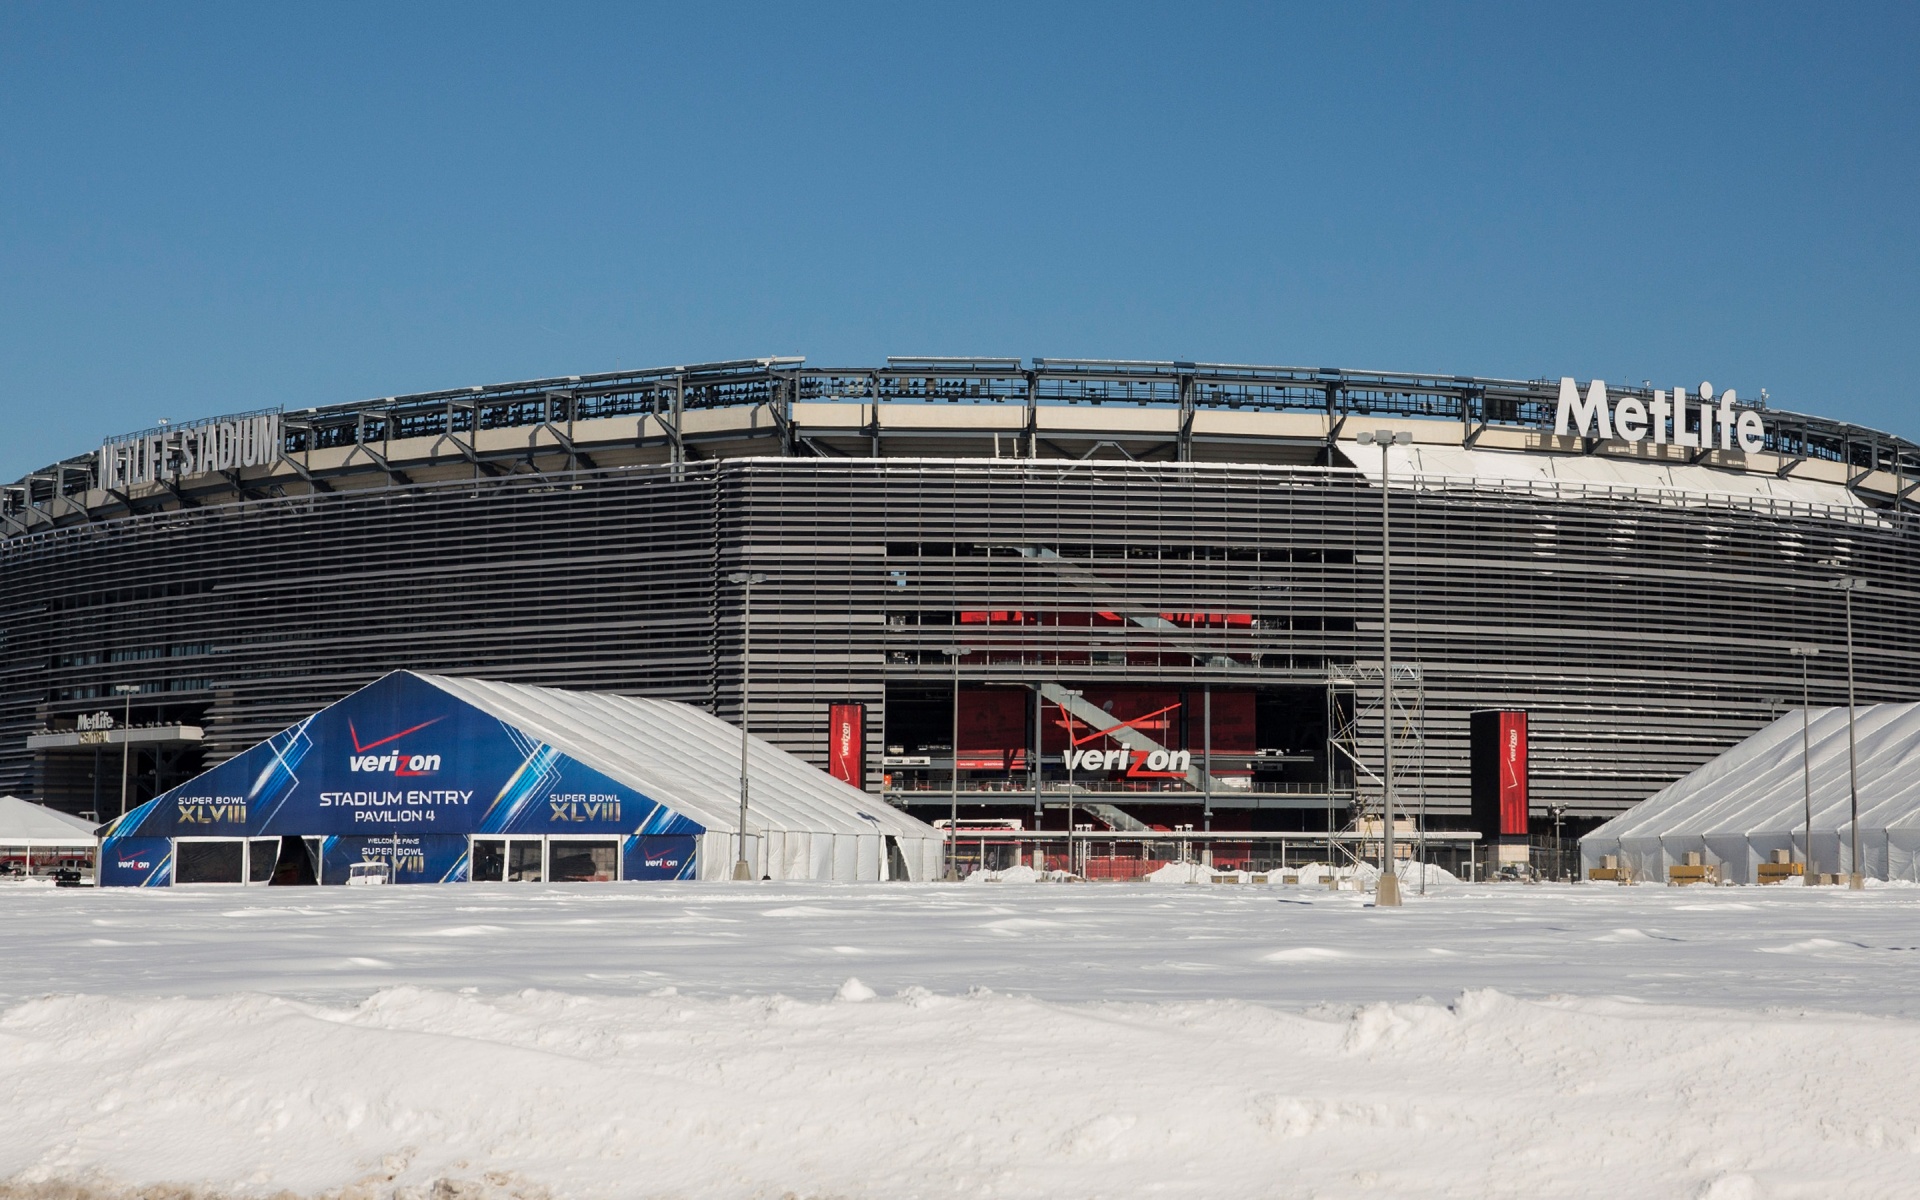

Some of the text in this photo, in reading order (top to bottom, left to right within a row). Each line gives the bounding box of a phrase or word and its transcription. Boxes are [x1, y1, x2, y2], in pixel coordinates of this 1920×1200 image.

[1554, 377, 1764, 454] MetLife
[98, 414, 278, 491] METLIFE STADIUM
[841, 722, 851, 757] verizon
[350, 750, 441, 776] verizon
[1063, 742, 1191, 777] verizon
[178, 796, 246, 805] SUPER BOWL
[319, 790, 473, 806] STADIUM ENTRY
[549, 794, 620, 802] SUPER BOWL
[177, 805, 246, 823] XLVIII
[355, 810, 436, 822] PAVILION 4
[549, 803, 620, 821] XLVIII
[361, 847, 393, 855] SUPER
[118, 860, 150, 870] verizon
[645, 858, 678, 869] verizon
